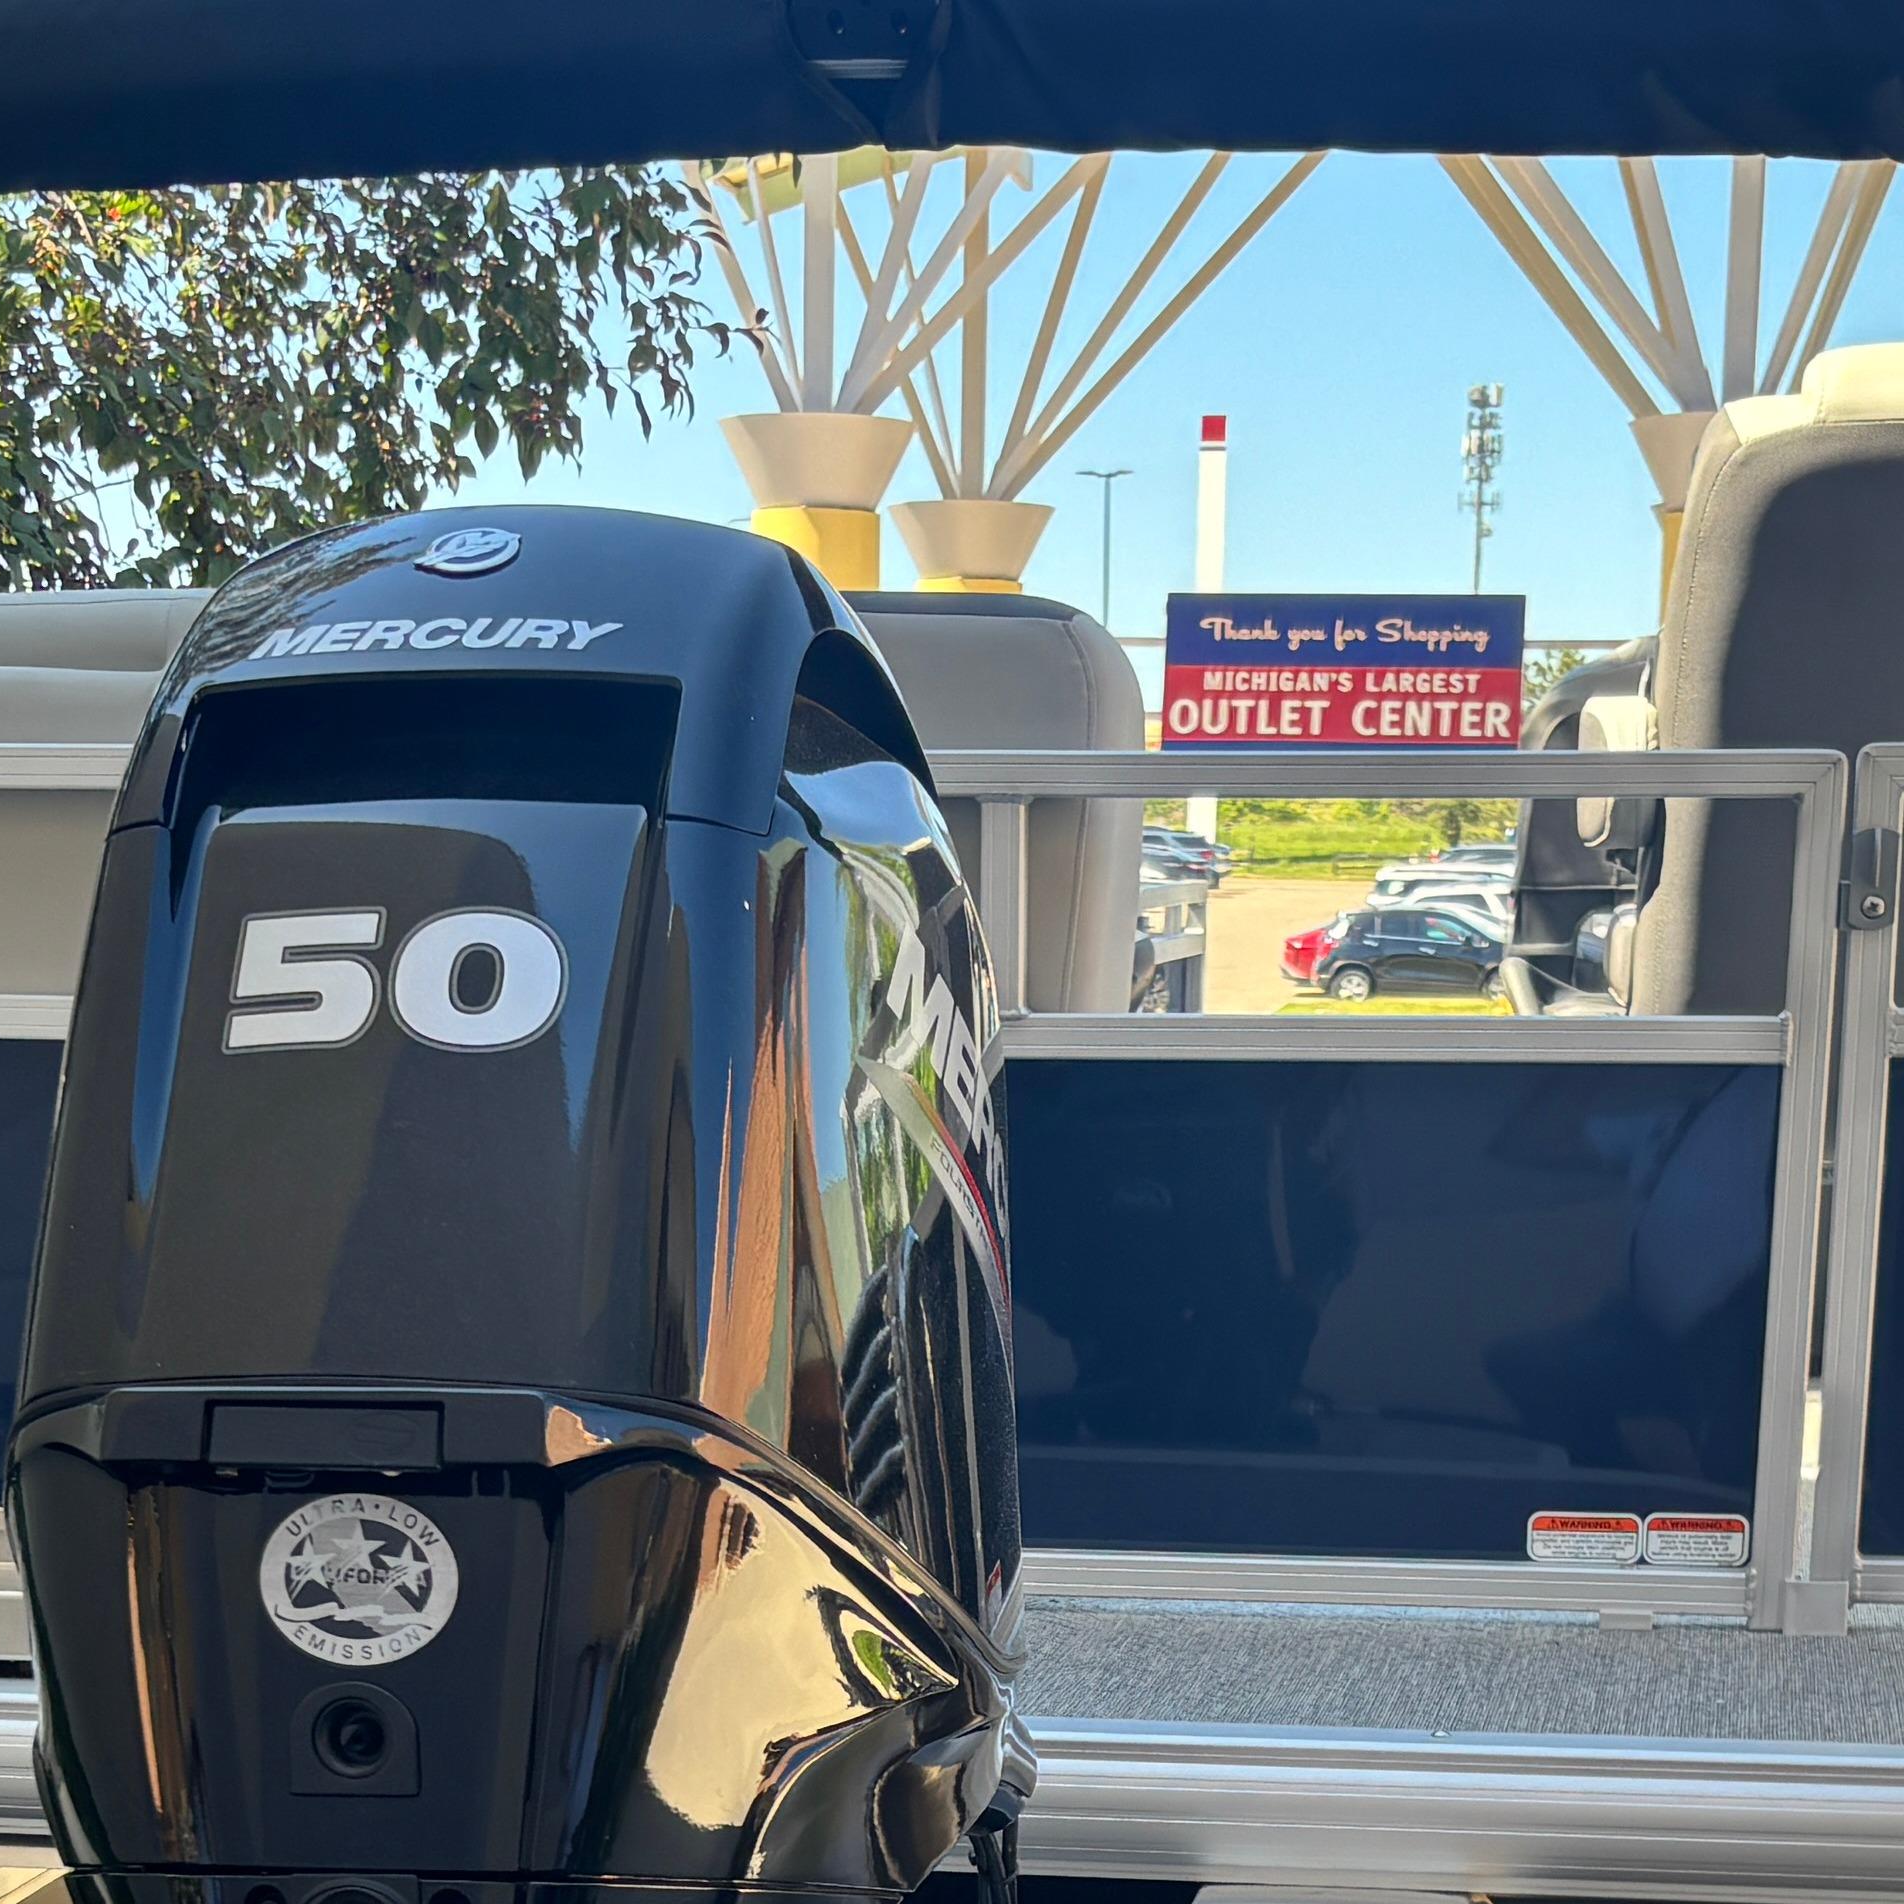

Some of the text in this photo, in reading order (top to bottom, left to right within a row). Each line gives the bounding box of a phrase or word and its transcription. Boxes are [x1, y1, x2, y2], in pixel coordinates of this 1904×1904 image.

[247, 617, 624, 661] MERCURY
[1199, 616, 1491, 653] Thank you for Shopping
[1202, 670, 1482, 694] MICHIGAN'S LARGEST
[1168, 697, 1512, 739] OUTLET CENTER
[221, 904, 569, 1055] 50
[886, 924, 1011, 1241] MERC
[285, 1497, 440, 1547] ULTRA LOW
[293, 1624, 422, 1660] EMISSION
